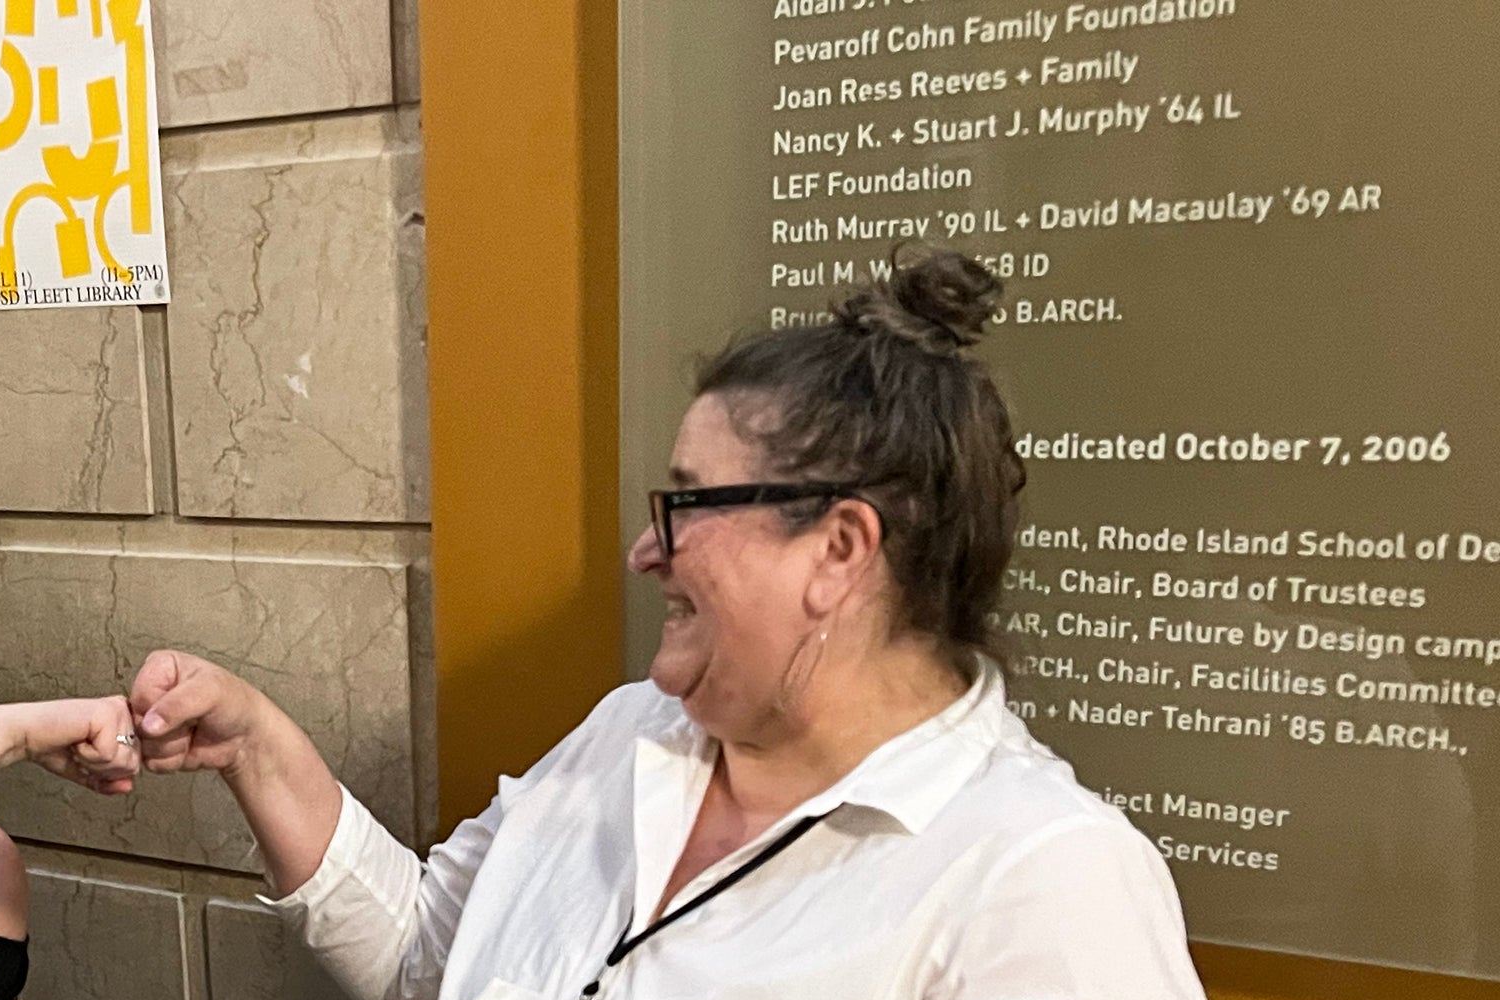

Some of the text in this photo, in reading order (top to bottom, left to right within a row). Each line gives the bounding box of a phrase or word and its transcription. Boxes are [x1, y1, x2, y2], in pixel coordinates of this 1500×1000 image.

[774, 0, 1235, 65] Pevaroff Cohn Family Foundation
[773, 50, 1138, 111] Joan Ress Reeves + Family
[773, 91, 1241, 156] Nancy K. + Stuart J. Murphy '64 IL
[772, 164, 972, 200] LEF Foundation
[772, 219, 828, 244] Ruth
[937, 210, 976, 238] '90
[984, 209, 1007, 233] IL
[1015, 211, 1031, 228] +
[1040, 198, 1118, 230] David
[1129, 191, 1274, 224] Macaulay
[1282, 185, 1331, 218] '69
[1339, 184, 1382, 211] AR
[771, 262, 824, 287] Paul
[1023, 253, 1050, 277] ID
[24, 286, 73, 305] FLEET
[77, 283, 142, 303] LIBRARY
[1016, 298, 1123, 324] B.ARCH.
[1015, 431, 1451, 466] dedicated October 7, 2006
[1018, 524, 1500, 563] dent, Rhode Island School of De
[1002, 568, 1426, 608] CH., Chair, Board of Trustees
[1006, 612, 1048, 638] AR,
[1056, 611, 1138, 644] Chair,
[1149, 617, 1244, 646] Future
[1254, 623, 1288, 653] by
[1297, 625, 1405, 660] Design
[1415, 636, 1500, 665] camp
[1098, 658, 1181, 690] Chair,
[1191, 664, 1326, 696] Facilities
[1336, 674, 1500, 707] Committe
[1006, 700, 1036, 719] on
[1068, 699, 1152, 729] Nader
[1162, 705, 1271, 738] Tehrani
[1280, 714, 1326, 744] '85
[1334, 720, 1468, 756] B.ARCH.,
[1102, 787, 1290, 830] ject Manager
[1157, 836, 1279, 870] Services
